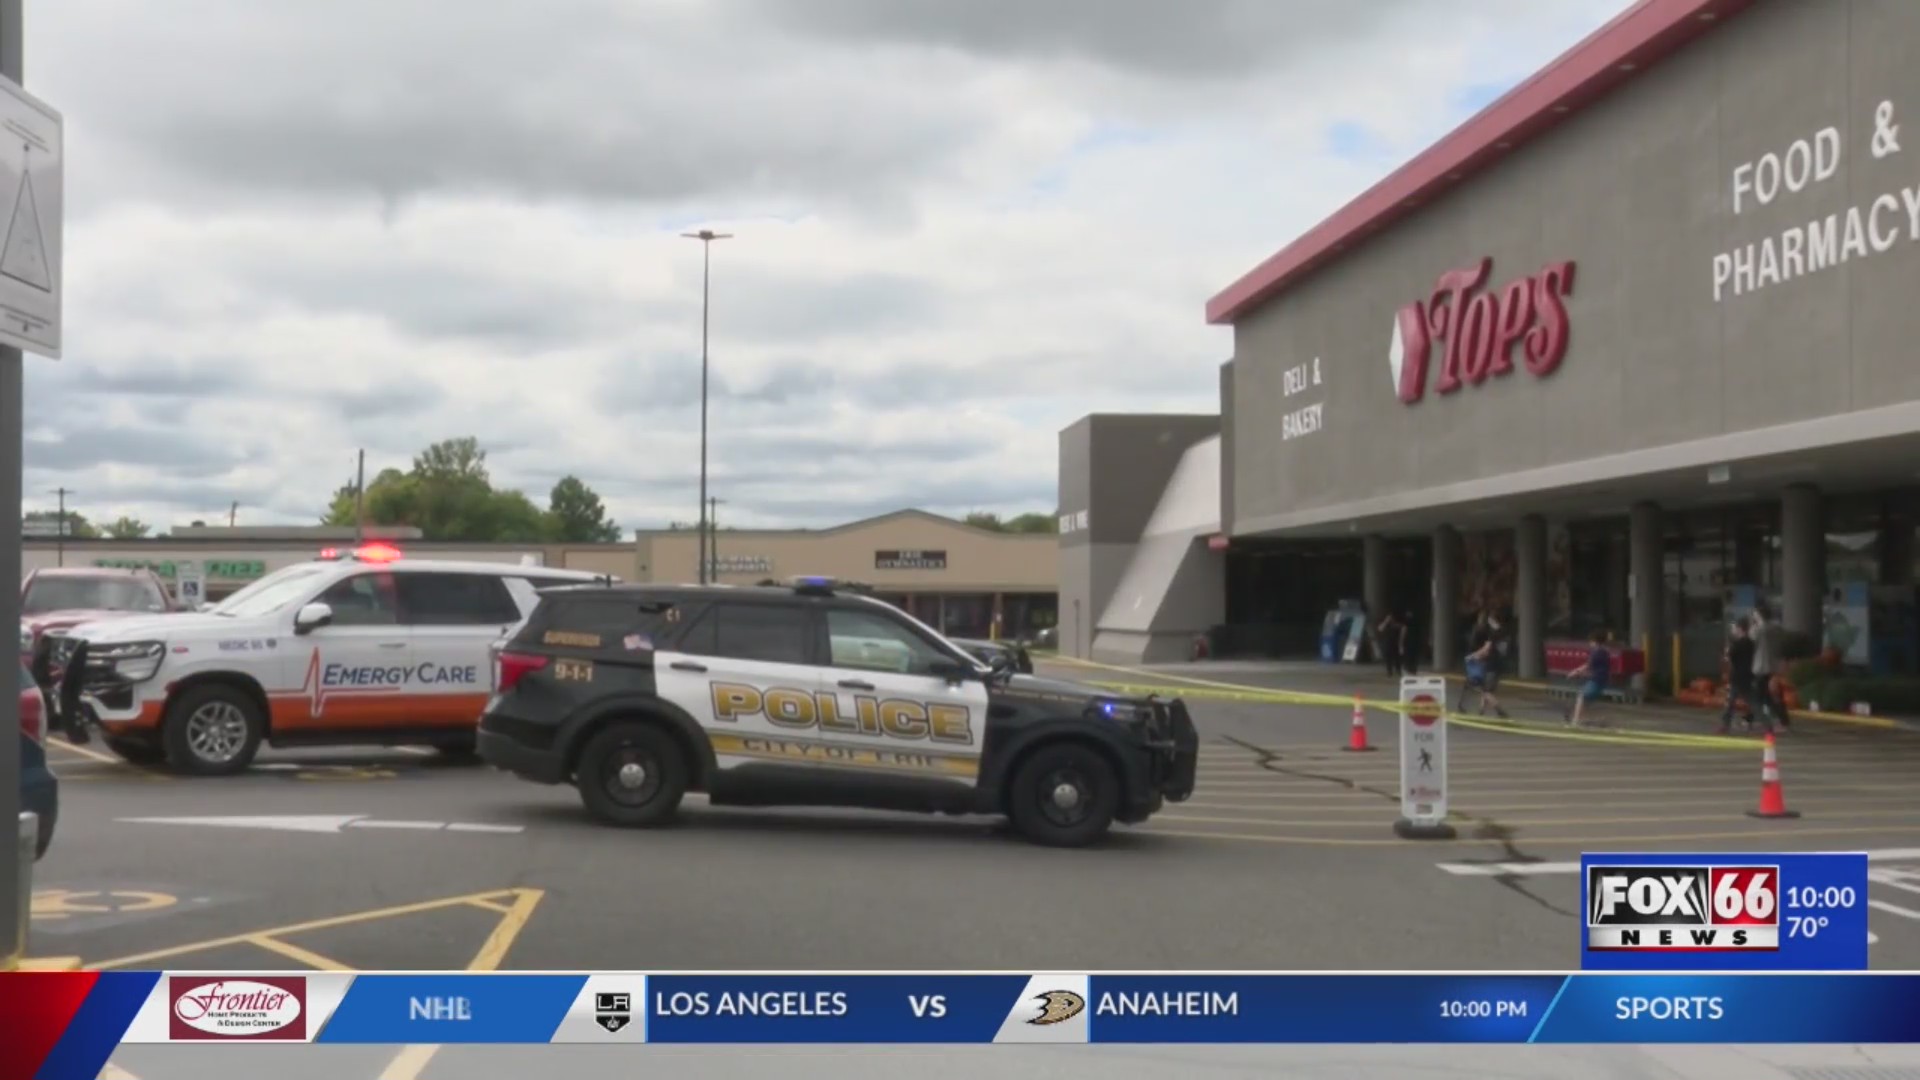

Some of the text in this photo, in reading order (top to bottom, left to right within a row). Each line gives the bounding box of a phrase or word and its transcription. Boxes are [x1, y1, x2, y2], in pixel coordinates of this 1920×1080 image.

[1733, 99, 1900, 215] FOOD &
[1712, 184, 1920, 302] PHARMACY
[1429, 257, 1576, 396] TOPS
[1284, 363, 1307, 397] DELI
[1283, 402, 1323, 441] BAKERY
[555, 663, 593, 682] 9-1-1
[709, 680, 974, 746] POLICE
